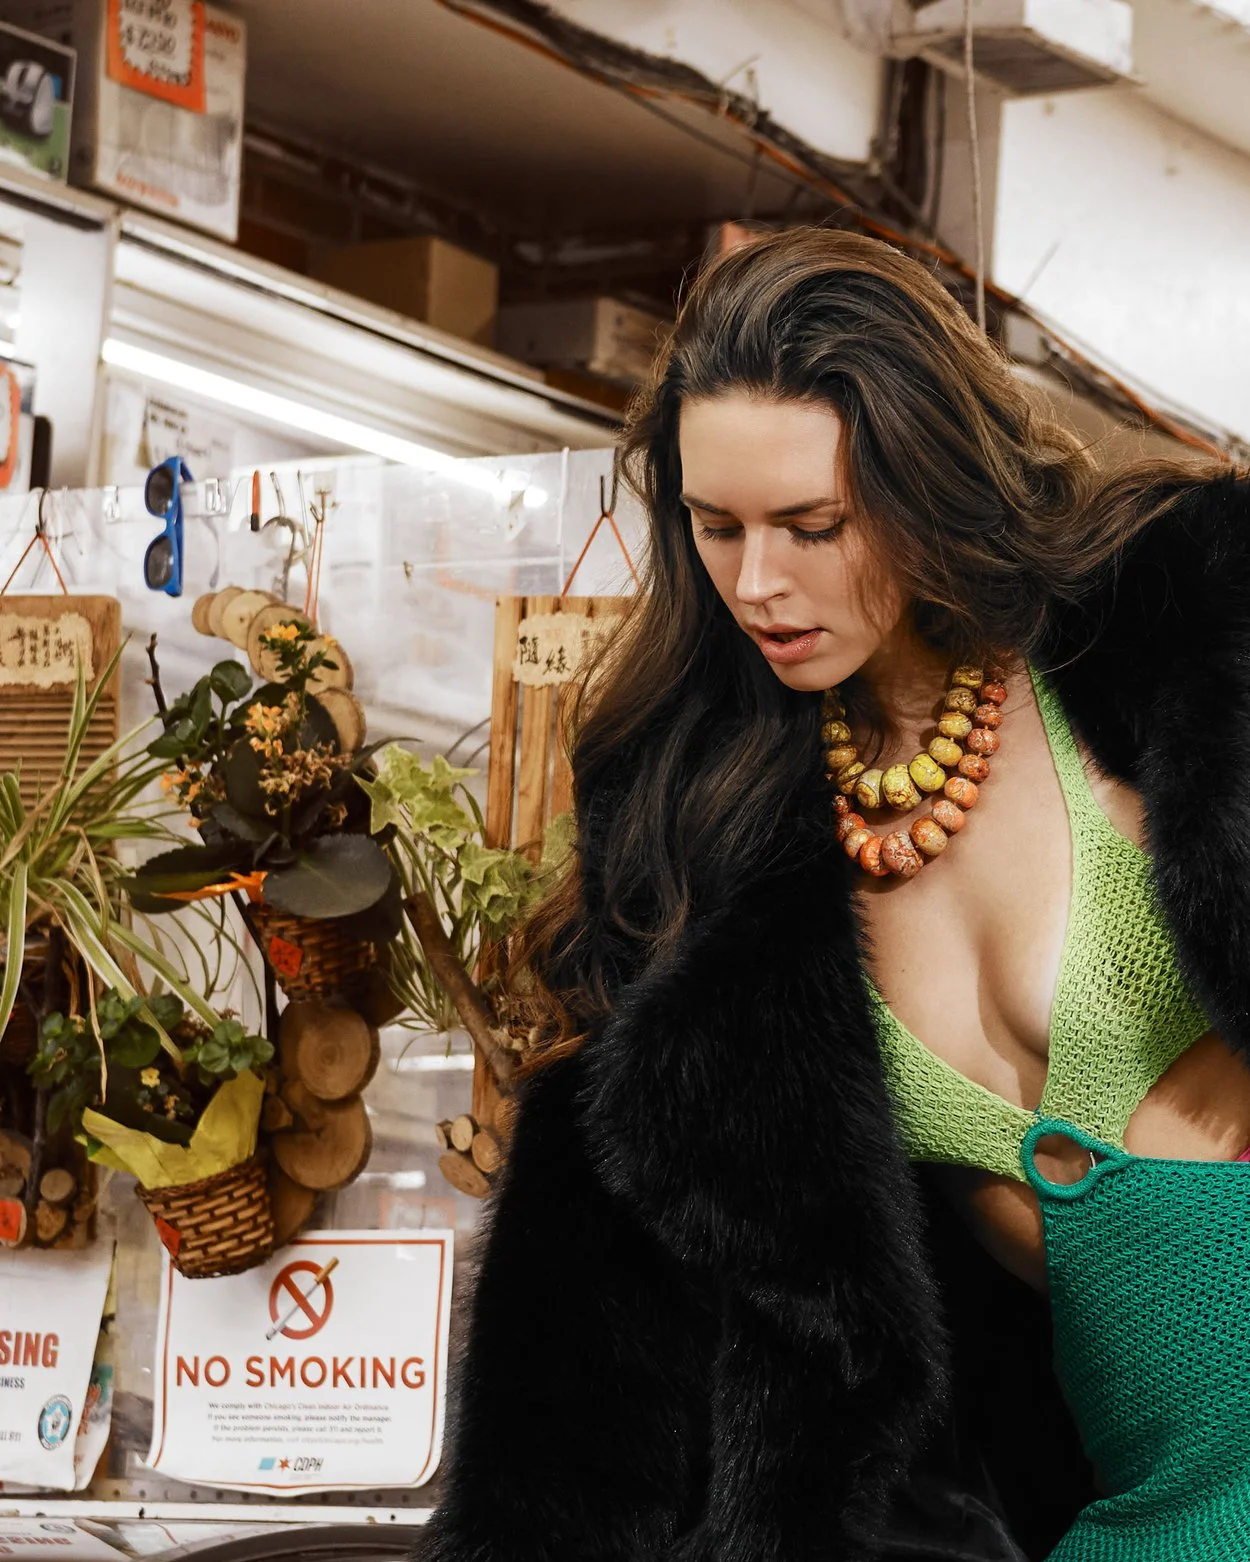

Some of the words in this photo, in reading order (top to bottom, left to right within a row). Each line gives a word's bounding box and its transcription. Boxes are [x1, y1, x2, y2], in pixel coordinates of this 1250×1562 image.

[176, 1355, 231, 1388] NO
[245, 1355, 426, 1389] SMOKING
[0, 1376, 25, 1388] INESS
[248, 1402, 262, 1410] with
[350, 1414, 361, 1422] the
[293, 1456, 324, 1472] CDPH
